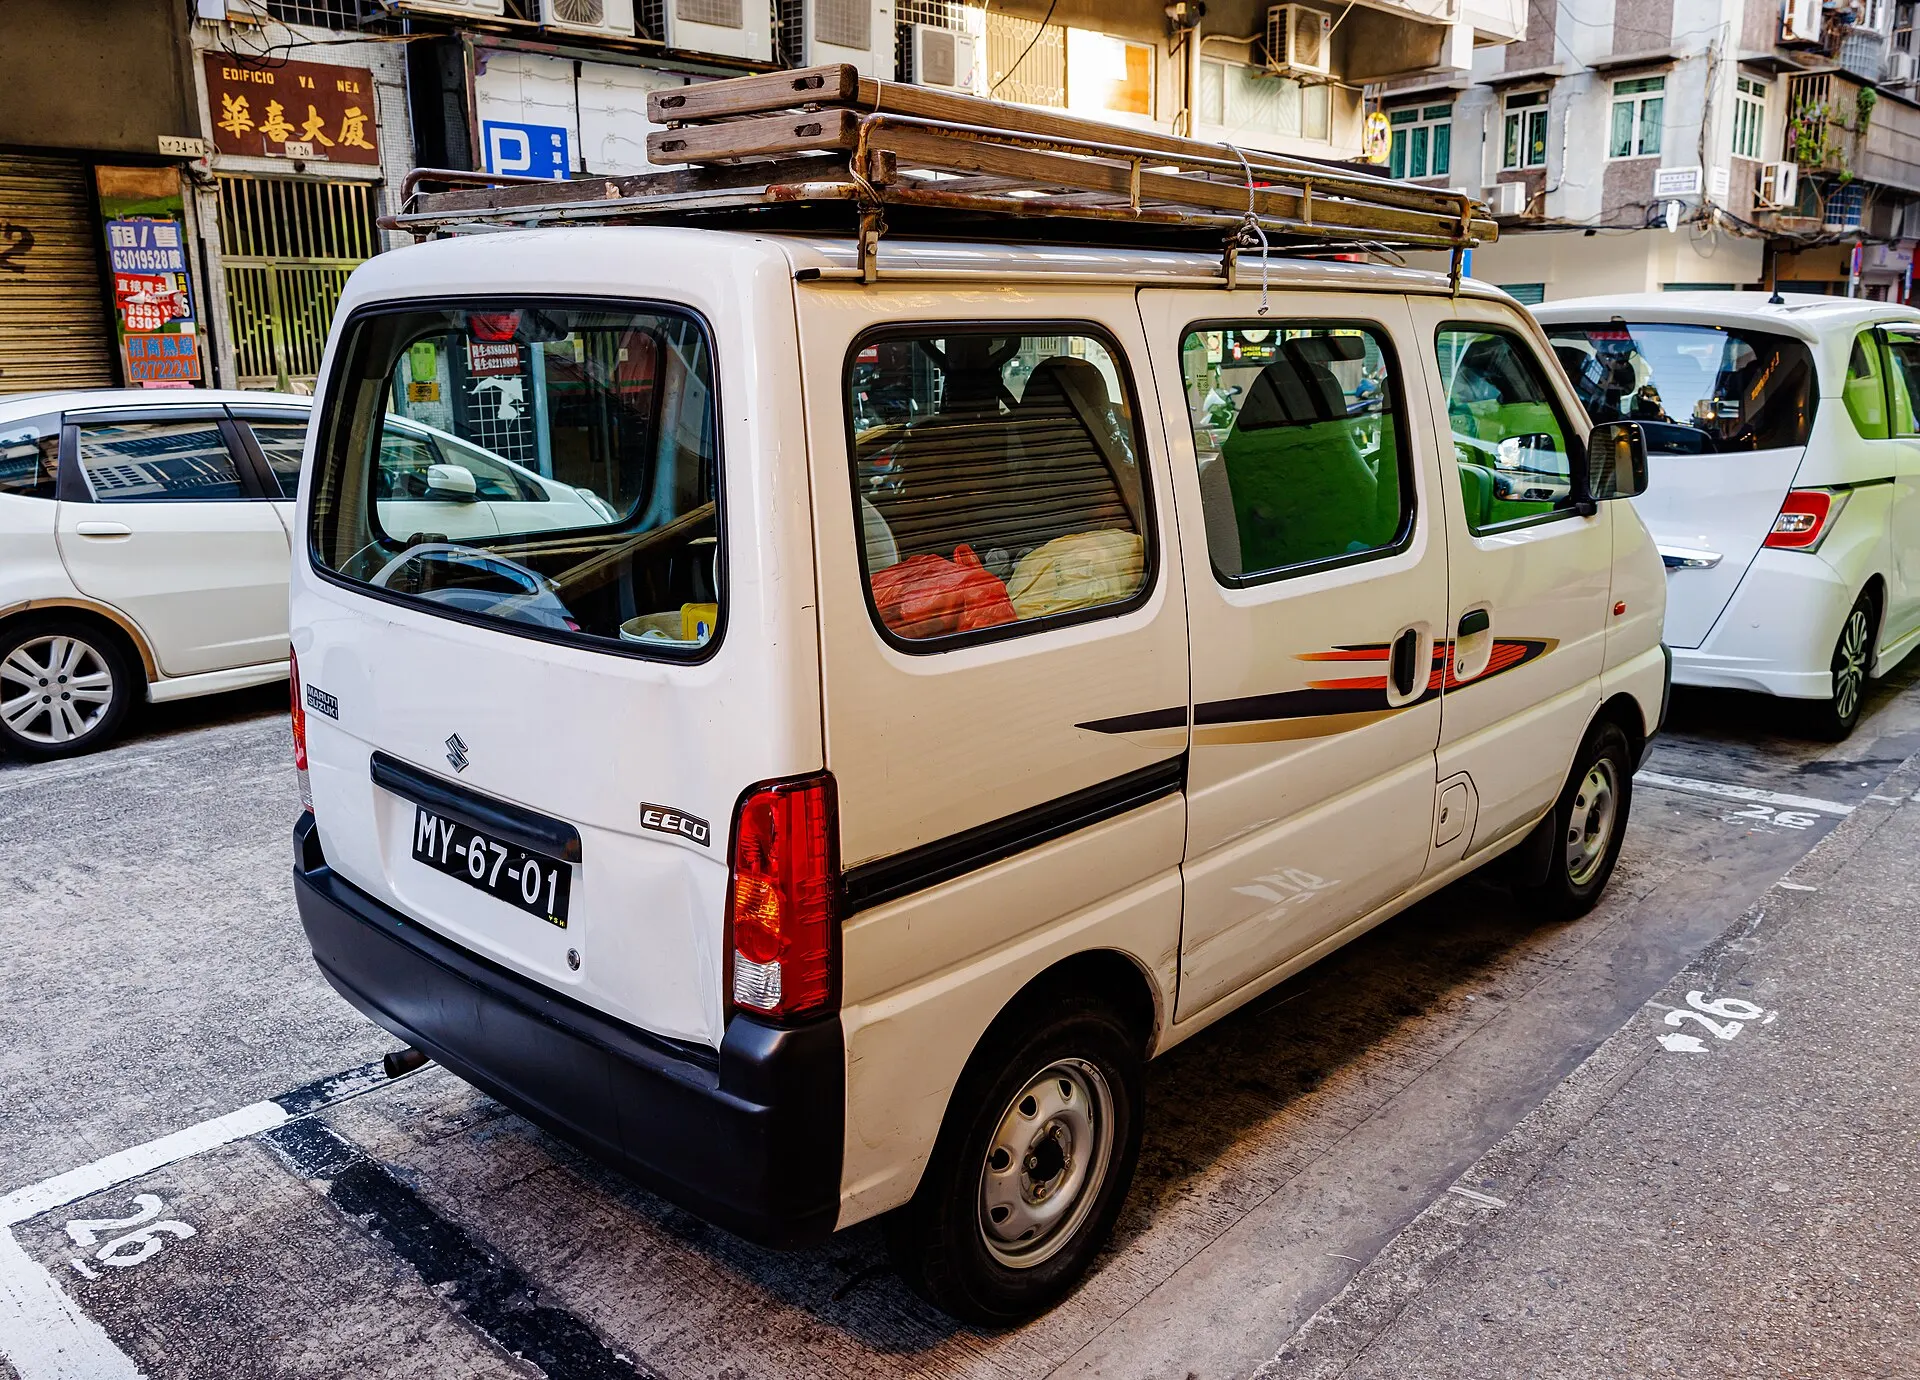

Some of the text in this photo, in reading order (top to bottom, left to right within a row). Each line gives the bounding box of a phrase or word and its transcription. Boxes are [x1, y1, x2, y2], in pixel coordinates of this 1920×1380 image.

[222, 67, 360, 94] EDIFICIO VA NEA
[299, 145, 310, 157] 26
[489, 127, 531, 176] P
[131, 360, 199, 379] 62722241
[307, 685, 338, 708] MARUTI
[307, 696, 338, 718] SUZUKI
[642, 810, 708, 841] EECO
[416, 810, 558, 915] MY-67-01
[1664, 990, 1765, 1041] 26
[65, 1193, 198, 1268] 26
